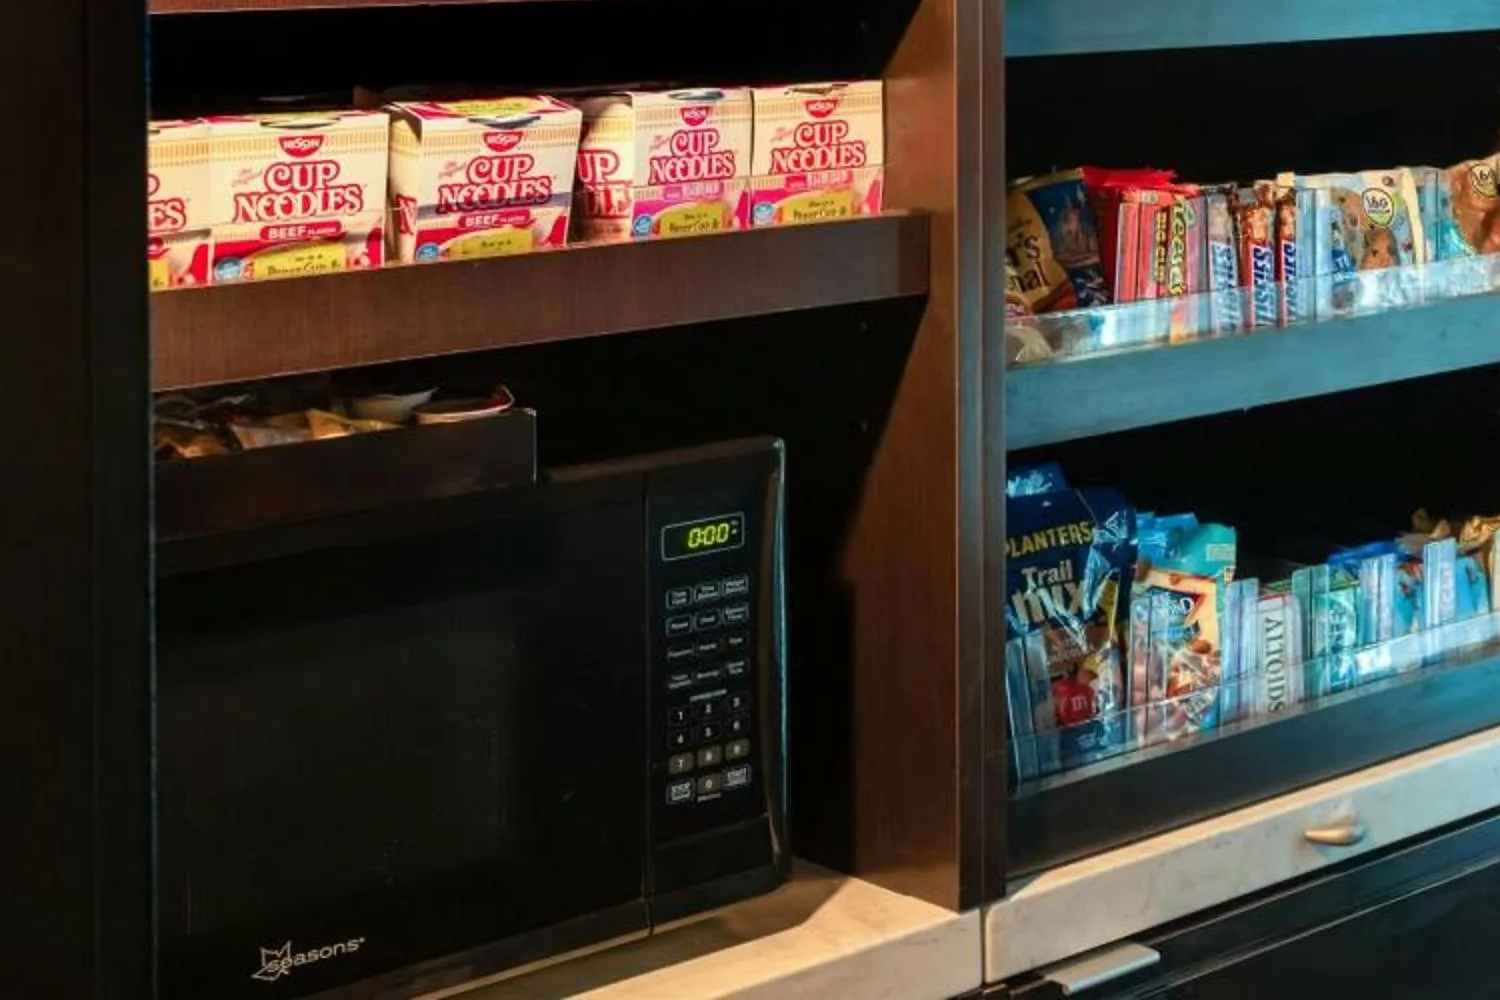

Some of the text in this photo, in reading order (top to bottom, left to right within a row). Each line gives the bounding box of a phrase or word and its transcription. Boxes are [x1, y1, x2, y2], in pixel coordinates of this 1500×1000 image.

[670, 128, 721, 157] CUP
[795, 119, 849, 148] CUP
[466, 153, 535, 185] CUP
[577, 149, 620, 184] UP
[648, 150, 736, 187] NOODLES
[768, 140, 867, 176] NOODLES
[263, 160, 341, 193] CUP
[231, 184, 365, 224] NOODLES
[435, 176, 552, 214] NOODLES
[268, 225, 308, 240] BEEF
[464, 214, 498, 227] BEEF
[687, 522, 730, 549] 0:00
